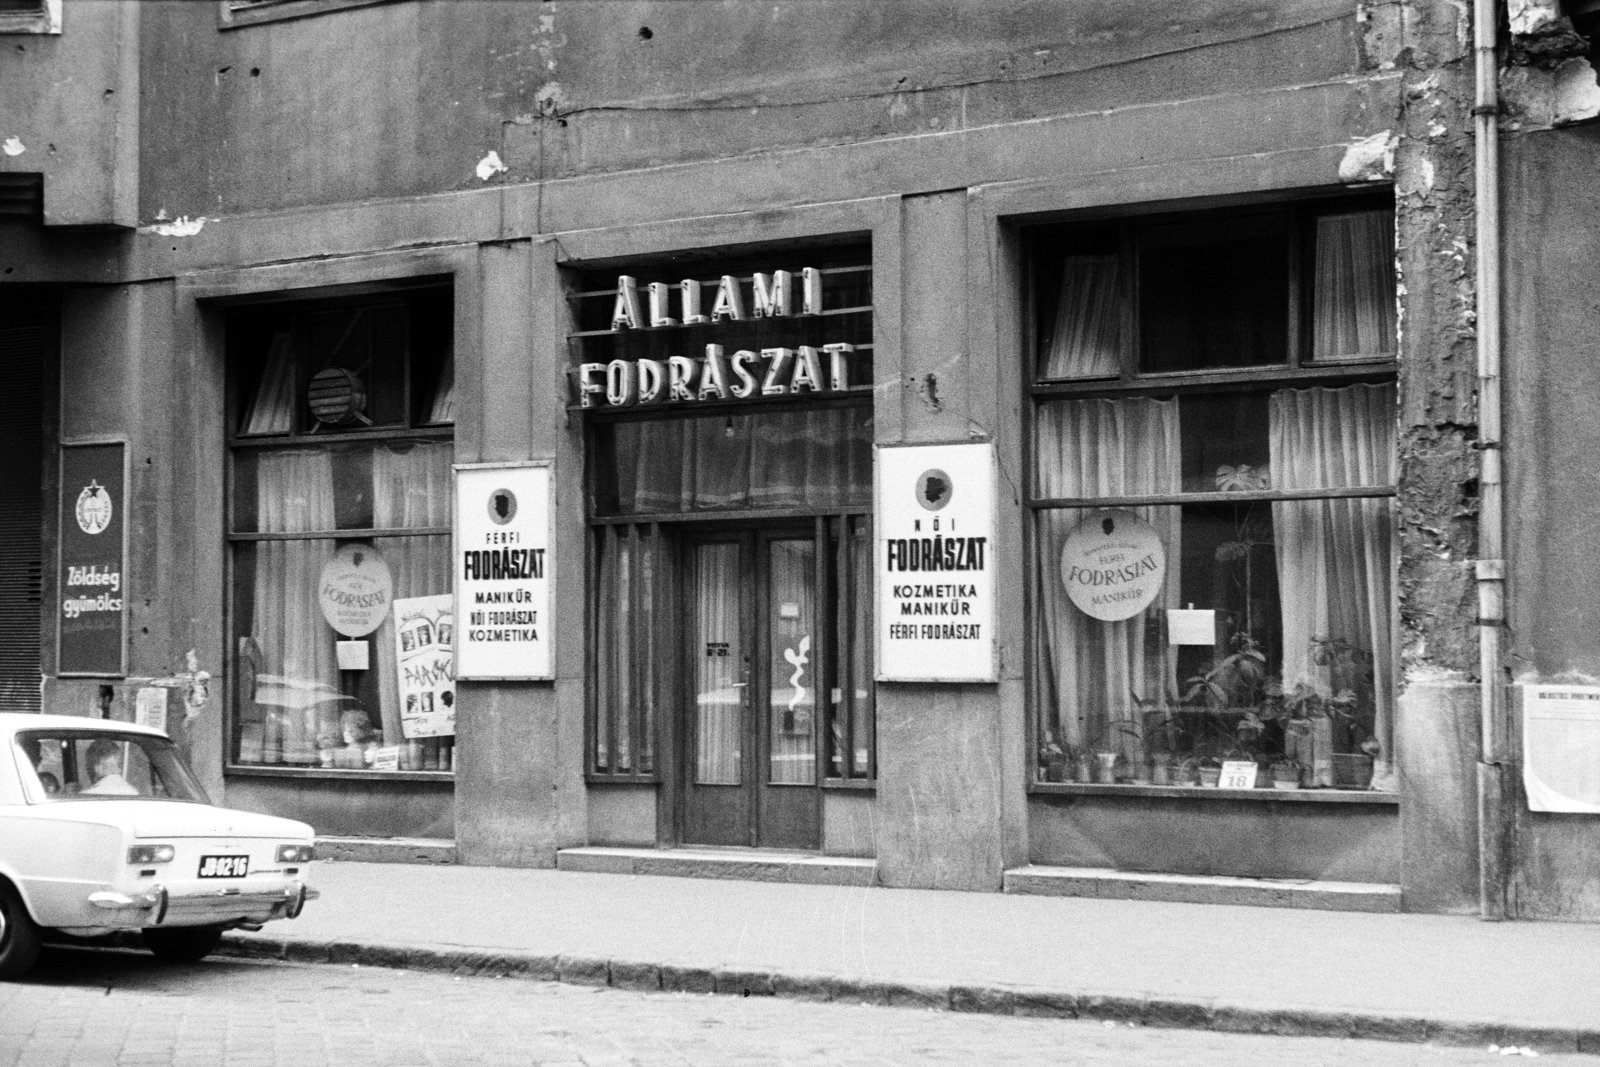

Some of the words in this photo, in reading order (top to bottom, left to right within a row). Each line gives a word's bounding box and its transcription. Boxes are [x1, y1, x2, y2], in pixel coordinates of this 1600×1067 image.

[611, 267, 823, 331] ÁLLAMI
[579, 343, 854, 408] FODRÁSZAT
[914, 516, 955, 532] NŐI
[464, 547, 546, 580] FODRÁSZAT
[887, 535, 987, 572] FODRÁSZAT
[67, 566, 120, 591] Zöldség
[893, 584, 978, 598] KOZMETIKA
[63, 592, 122, 618] gyümölcs
[488, 608, 538, 625] FODRÁSZAT
[469, 629, 539, 642] KOZMETIKA
[890, 622, 918, 640] FÉRFI
[921, 621, 981, 640] FODRÁSZAT
